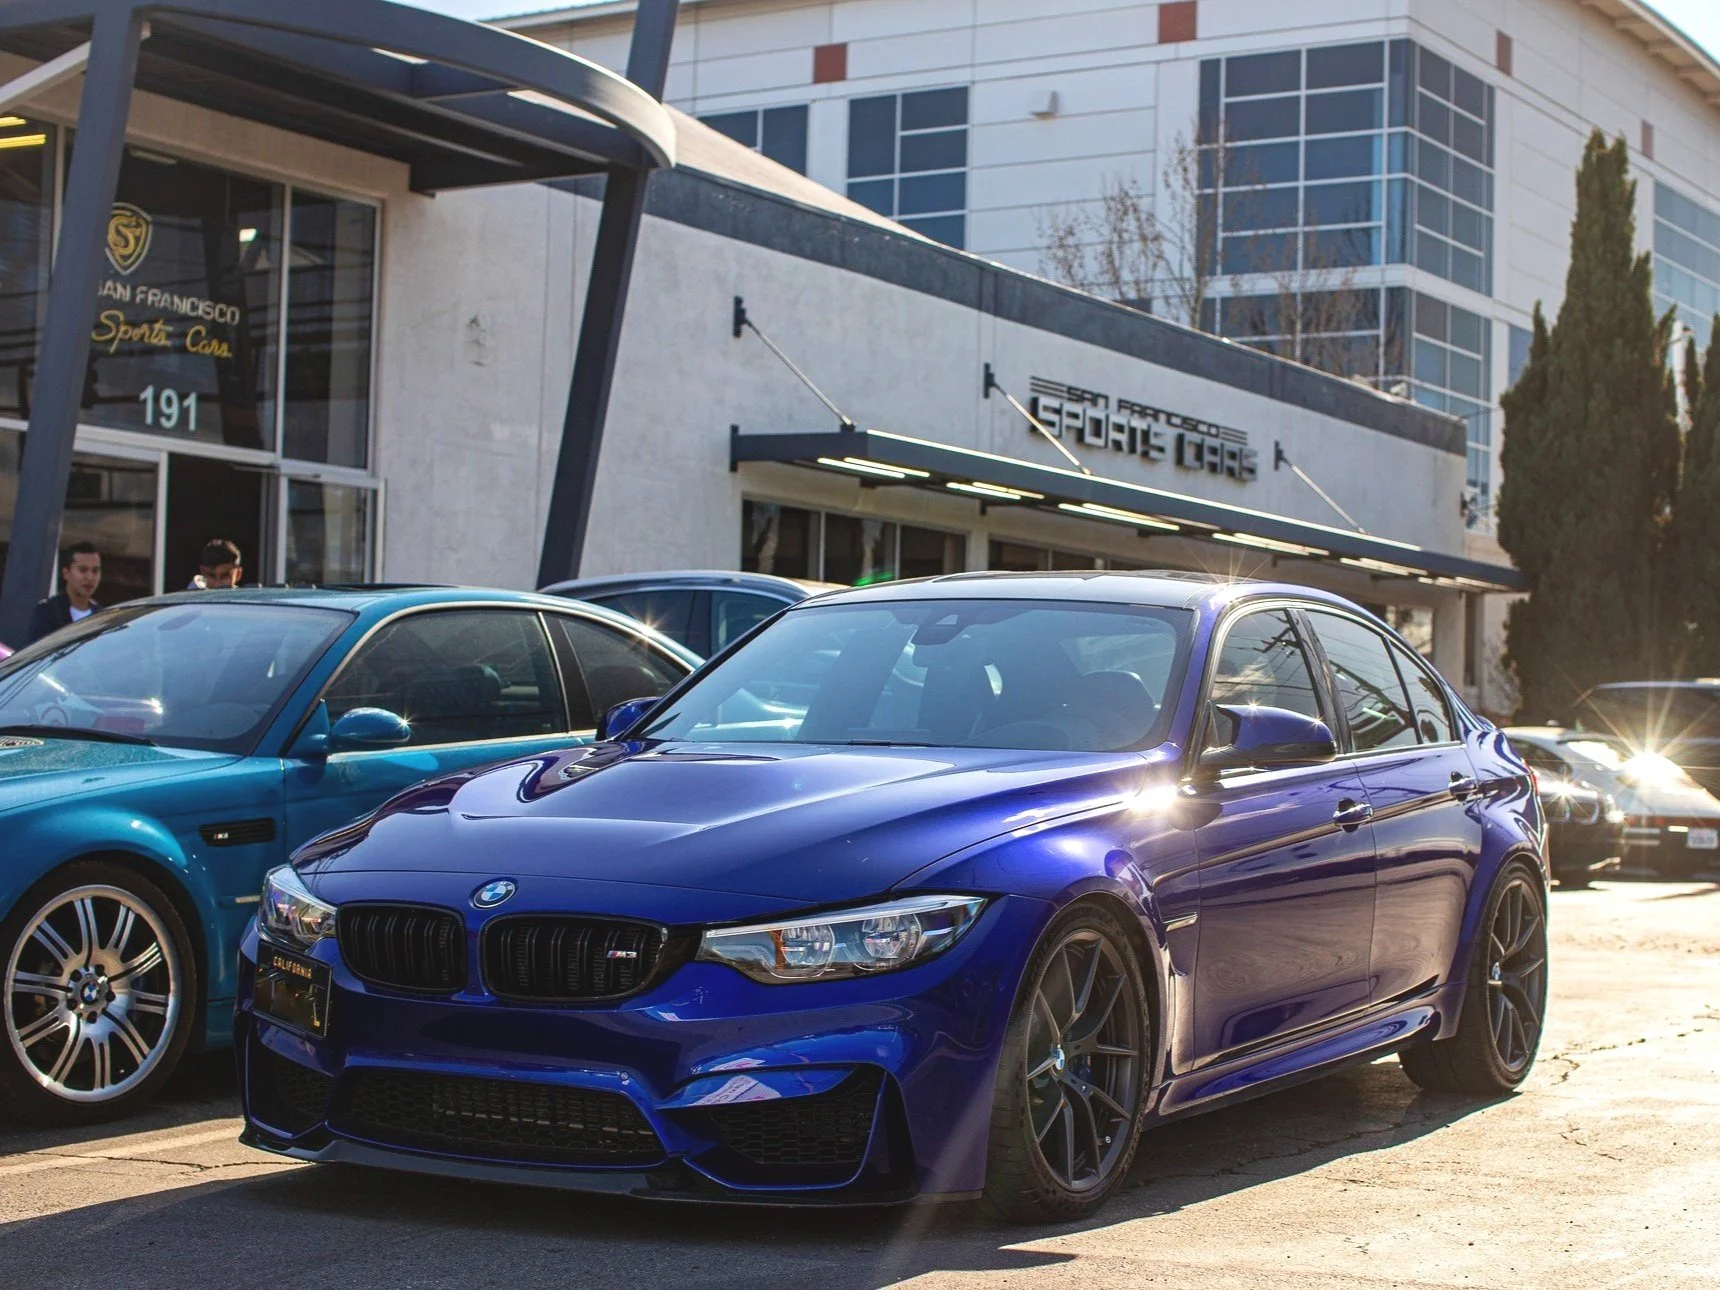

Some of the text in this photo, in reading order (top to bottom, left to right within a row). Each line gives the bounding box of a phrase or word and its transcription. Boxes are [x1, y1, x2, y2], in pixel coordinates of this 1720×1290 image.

[98, 279, 240, 326] AN FRANCISCO
[91, 309, 232, 359] Sports Cars
[139, 384, 197, 431] 191
[1067, 385, 1220, 438] SAN FRANCISCO
[1030, 395, 1258, 483] SPORTS CARS
